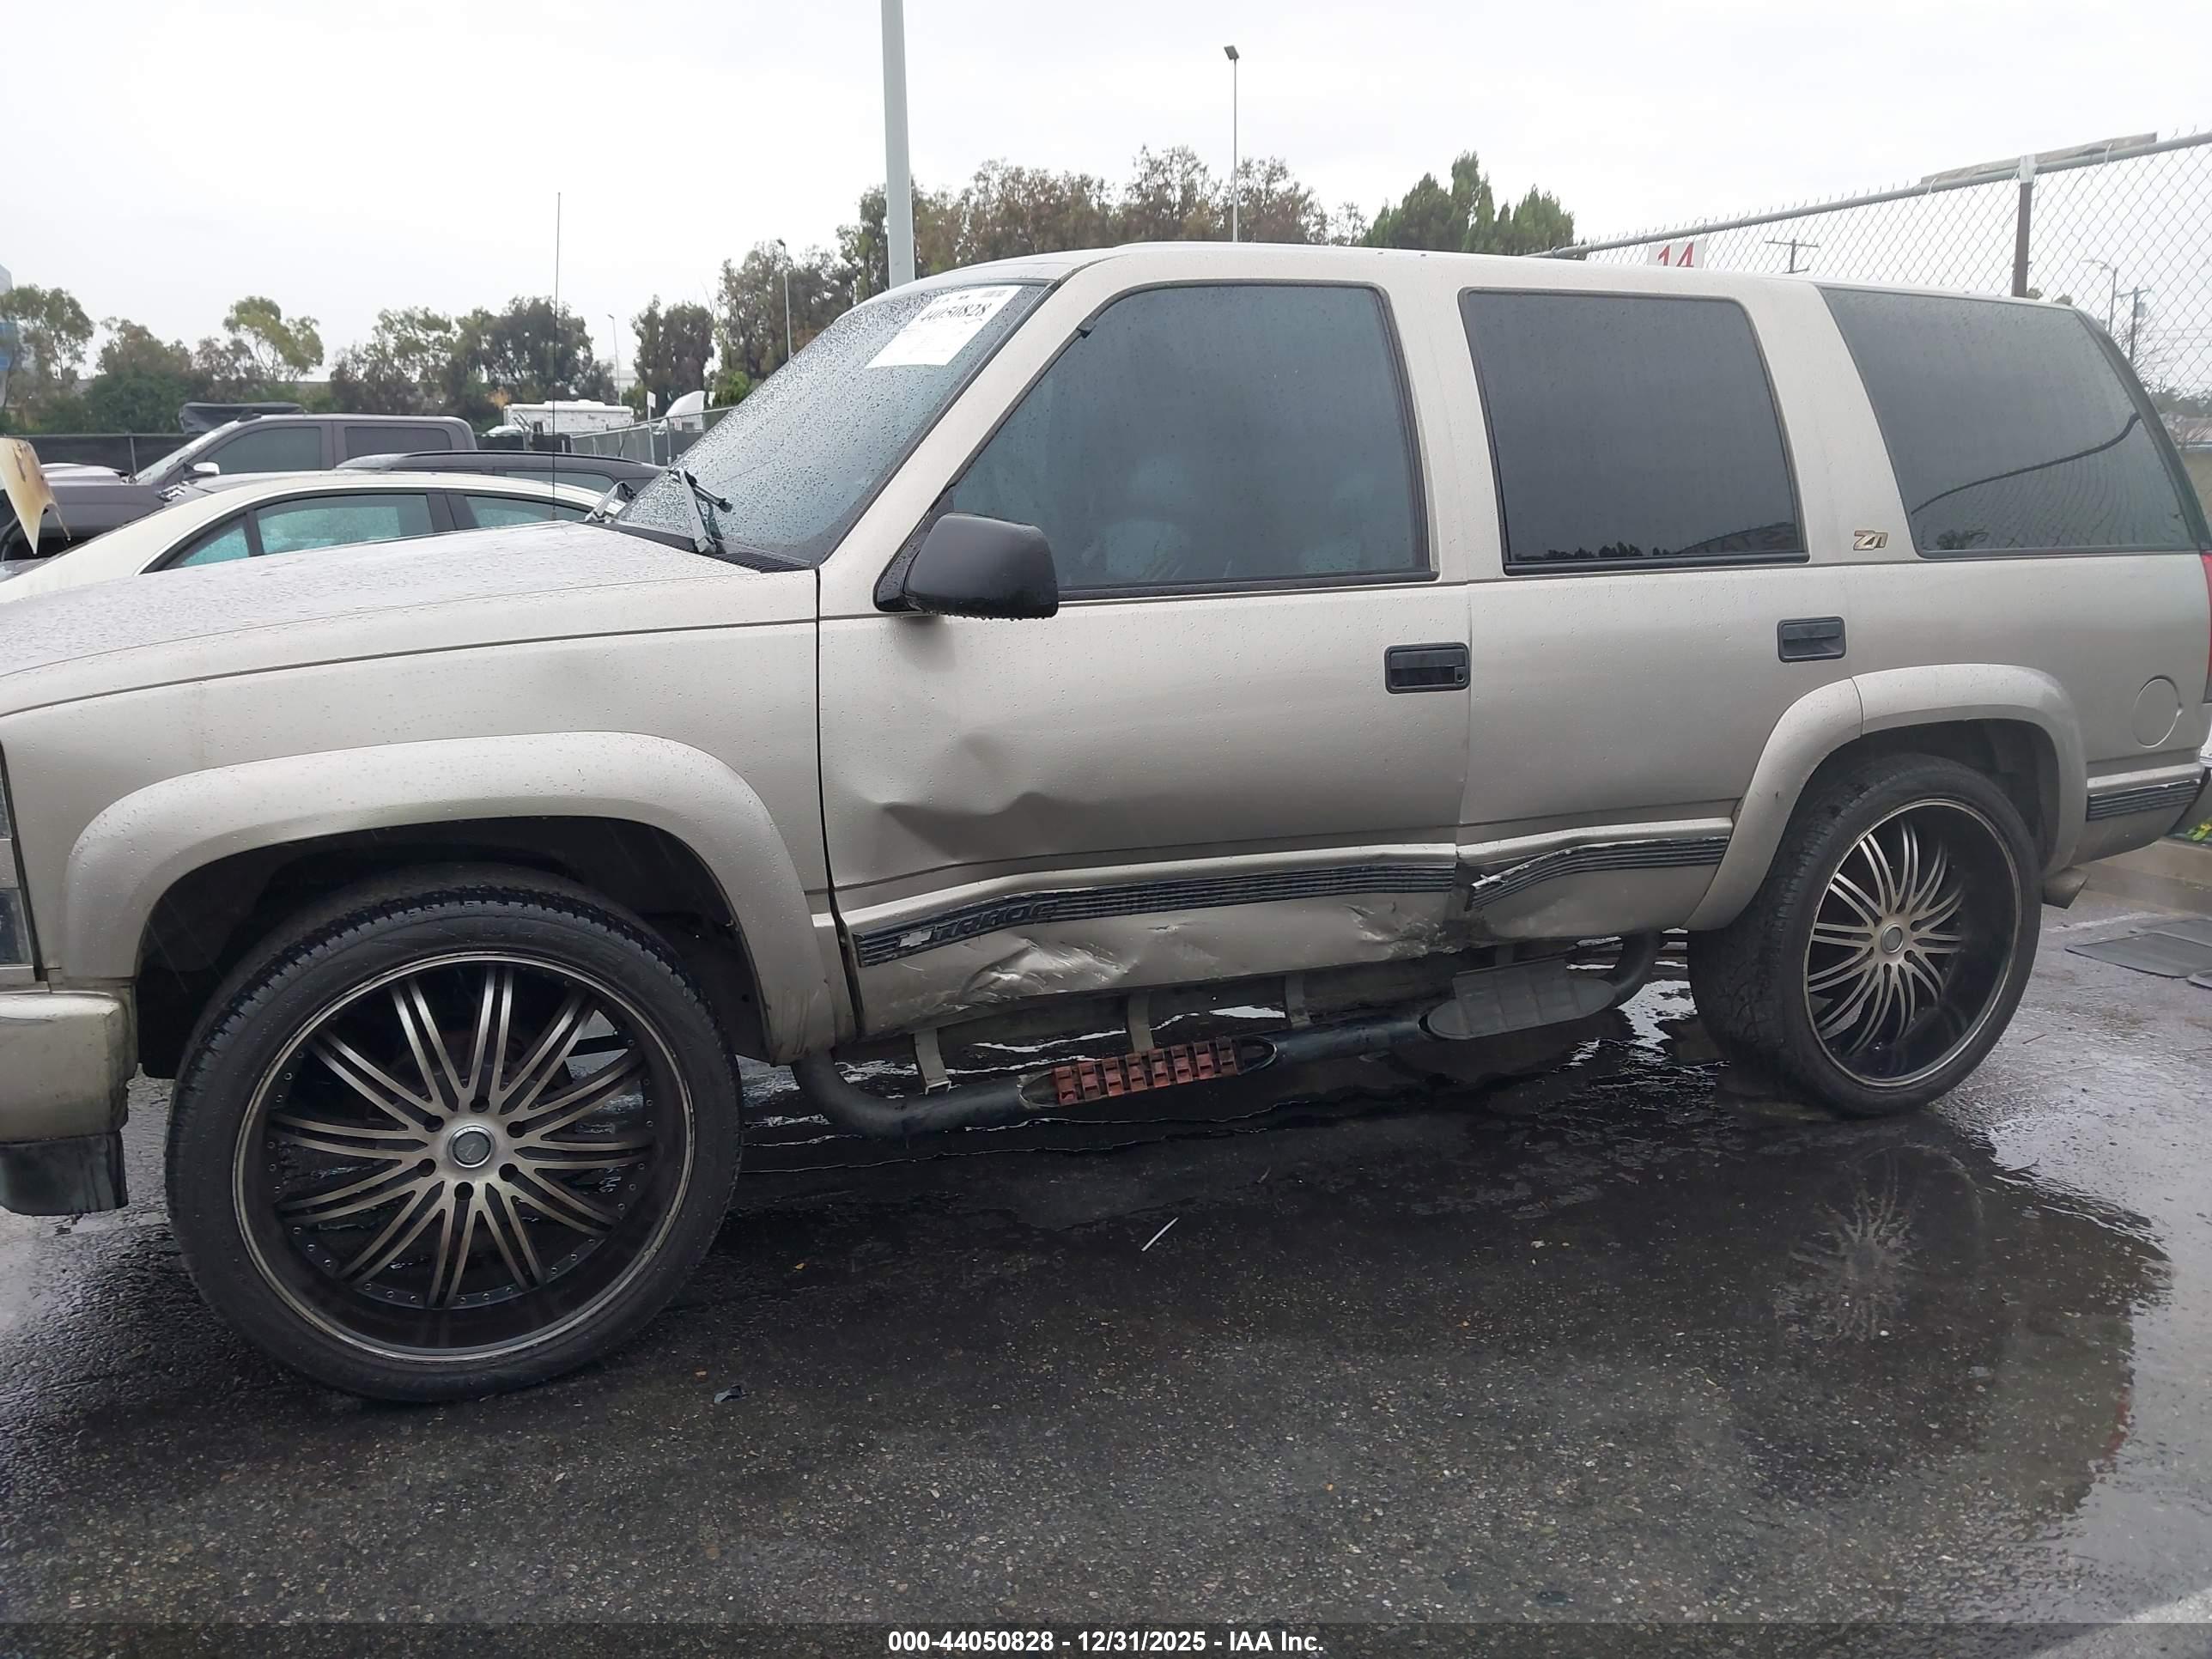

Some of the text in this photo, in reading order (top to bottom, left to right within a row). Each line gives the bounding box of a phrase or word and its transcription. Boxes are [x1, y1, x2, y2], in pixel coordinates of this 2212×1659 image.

[1657, 242, 1694, 267] 14
[920, 302, 993, 322] 44050828
[933, 899, 1059, 941] TAHOE
